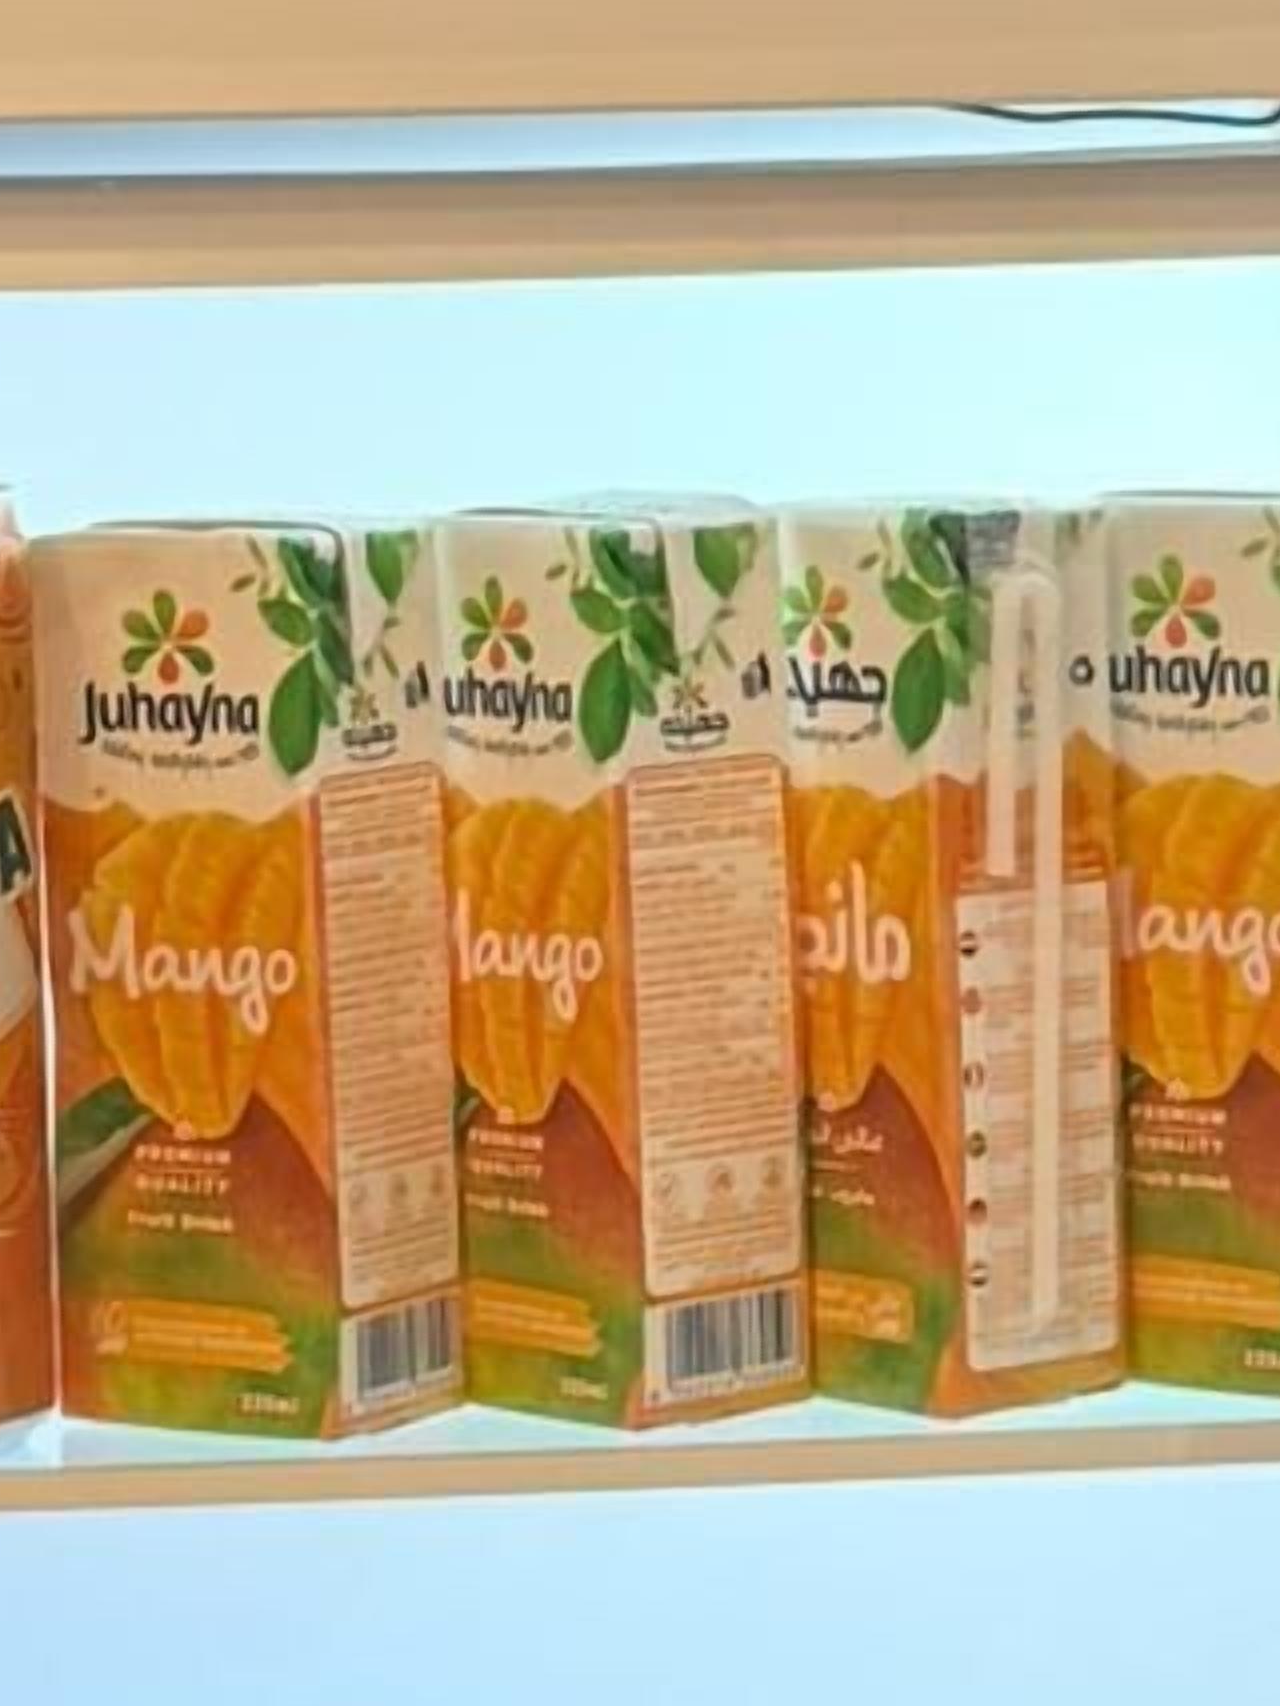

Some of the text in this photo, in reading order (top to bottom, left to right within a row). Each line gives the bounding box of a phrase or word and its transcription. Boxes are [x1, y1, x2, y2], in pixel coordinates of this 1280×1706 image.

[444, 668, 572, 732] uhayna
[1108, 646, 1270, 709] uhayna
[78, 680, 259, 745] Juhayna
[67, 902, 297, 1037] Mango
